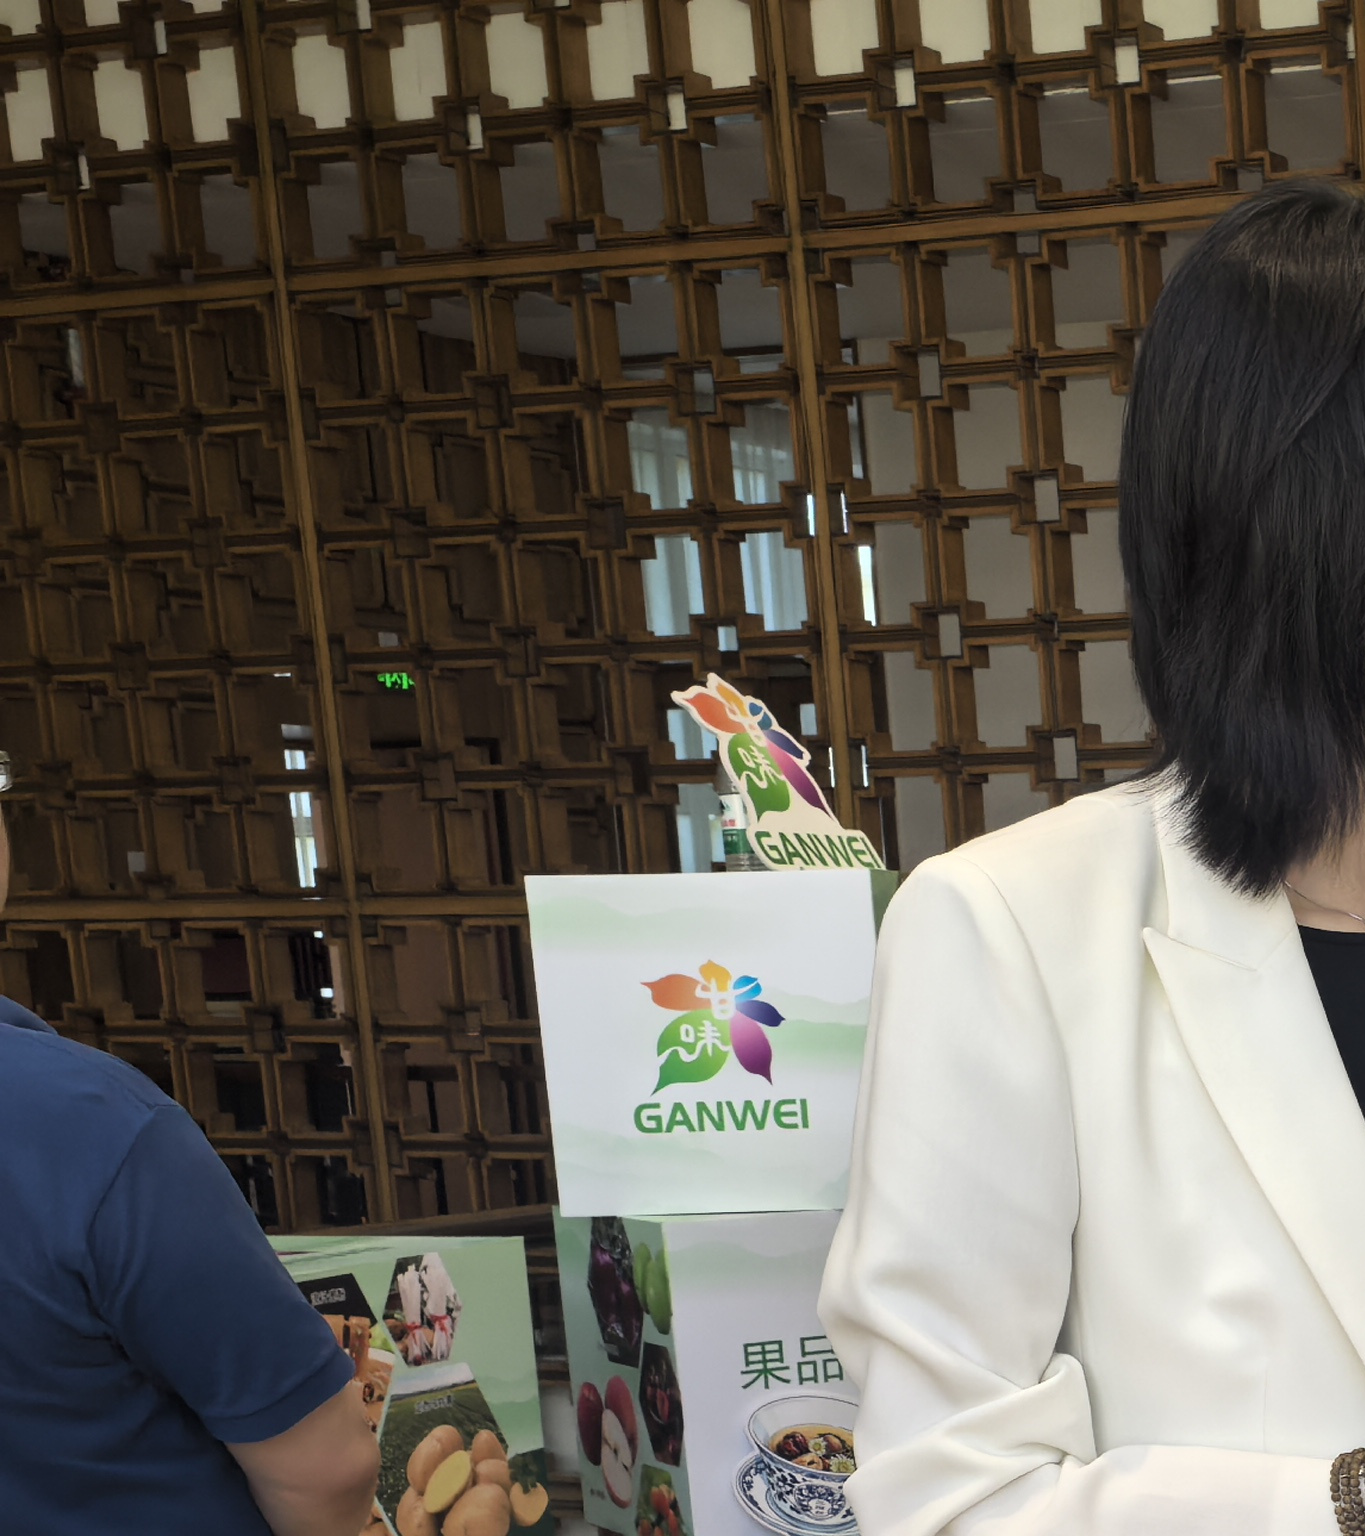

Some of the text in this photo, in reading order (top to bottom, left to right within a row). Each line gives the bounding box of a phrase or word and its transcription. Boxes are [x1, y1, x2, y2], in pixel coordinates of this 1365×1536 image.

[757, 831, 881, 867] GANWEI
[633, 1098, 810, 1134] GANWEI
[740, 1335, 844, 1391] 果品
